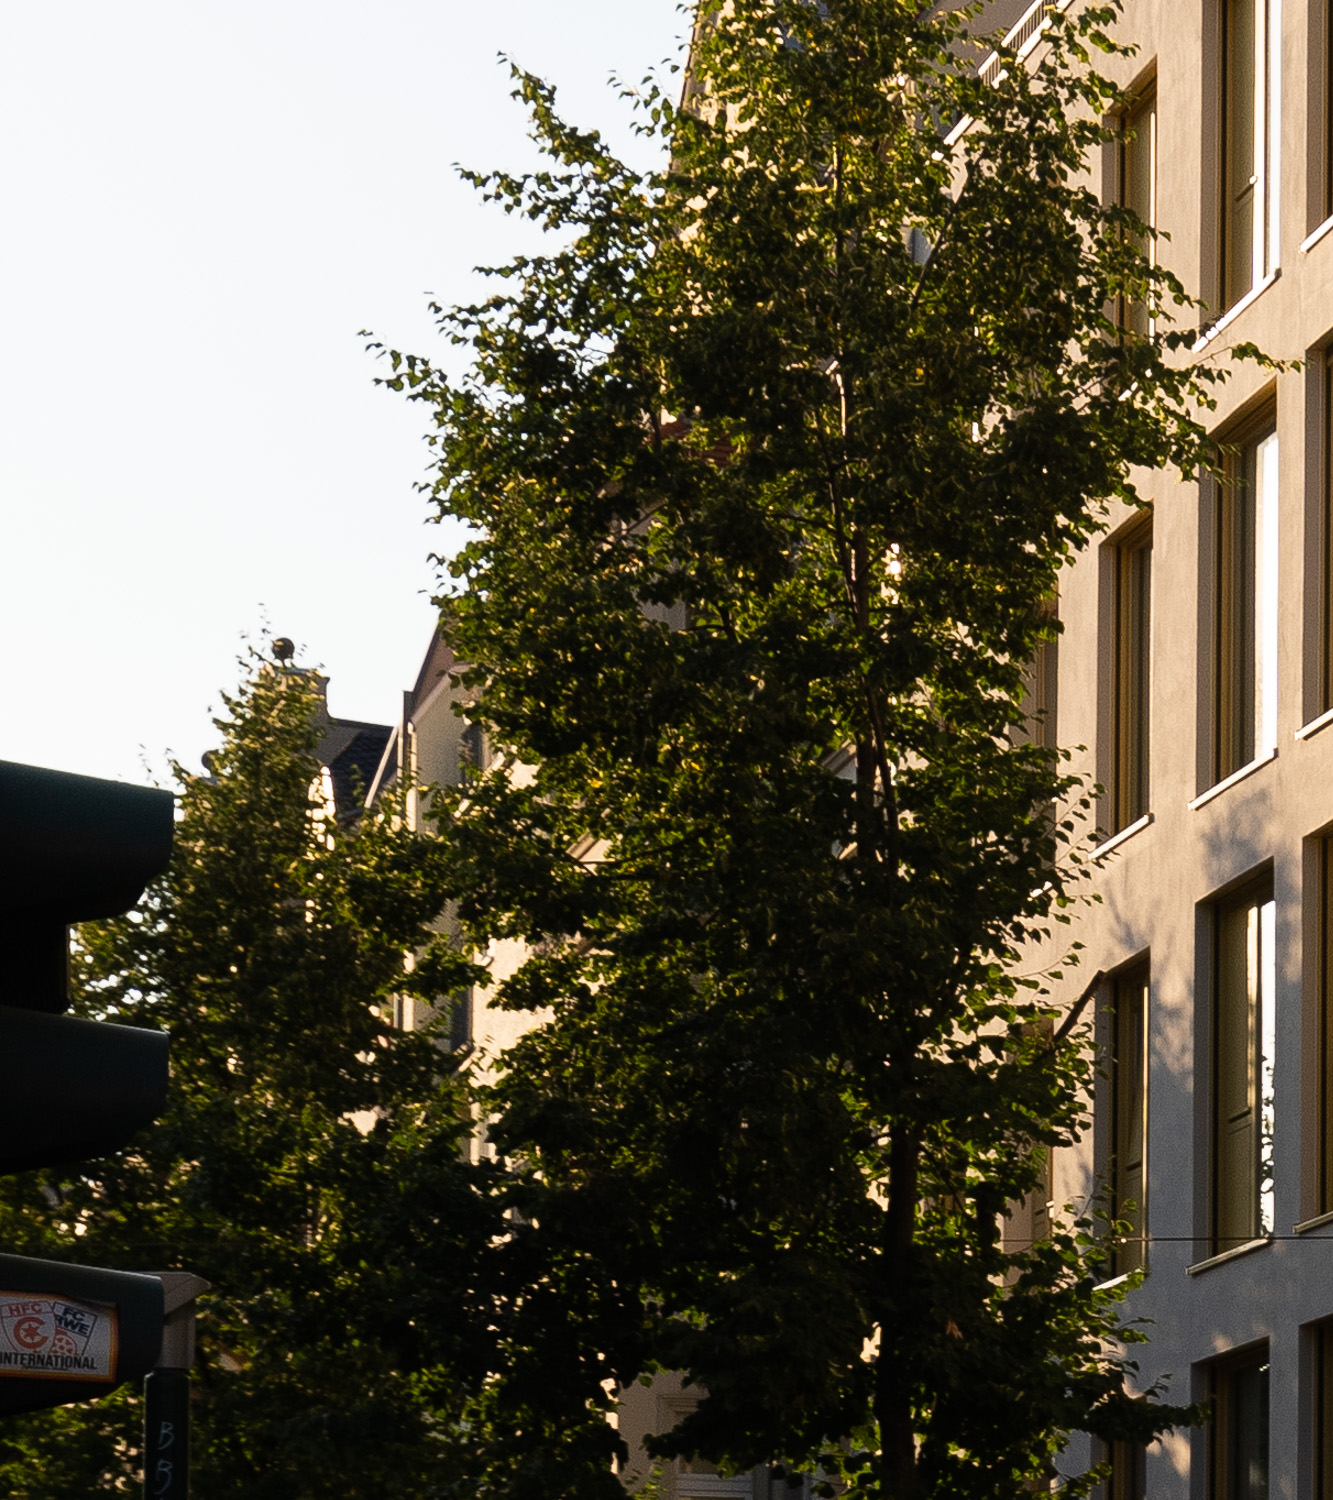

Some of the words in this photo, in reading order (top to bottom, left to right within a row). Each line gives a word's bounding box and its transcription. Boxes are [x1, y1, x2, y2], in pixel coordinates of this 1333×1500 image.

[9, 1304, 42, 1316] HFC
[62, 1307, 86, 1321] FC
[0, 1351, 97, 1370] INTERNATIONAL
